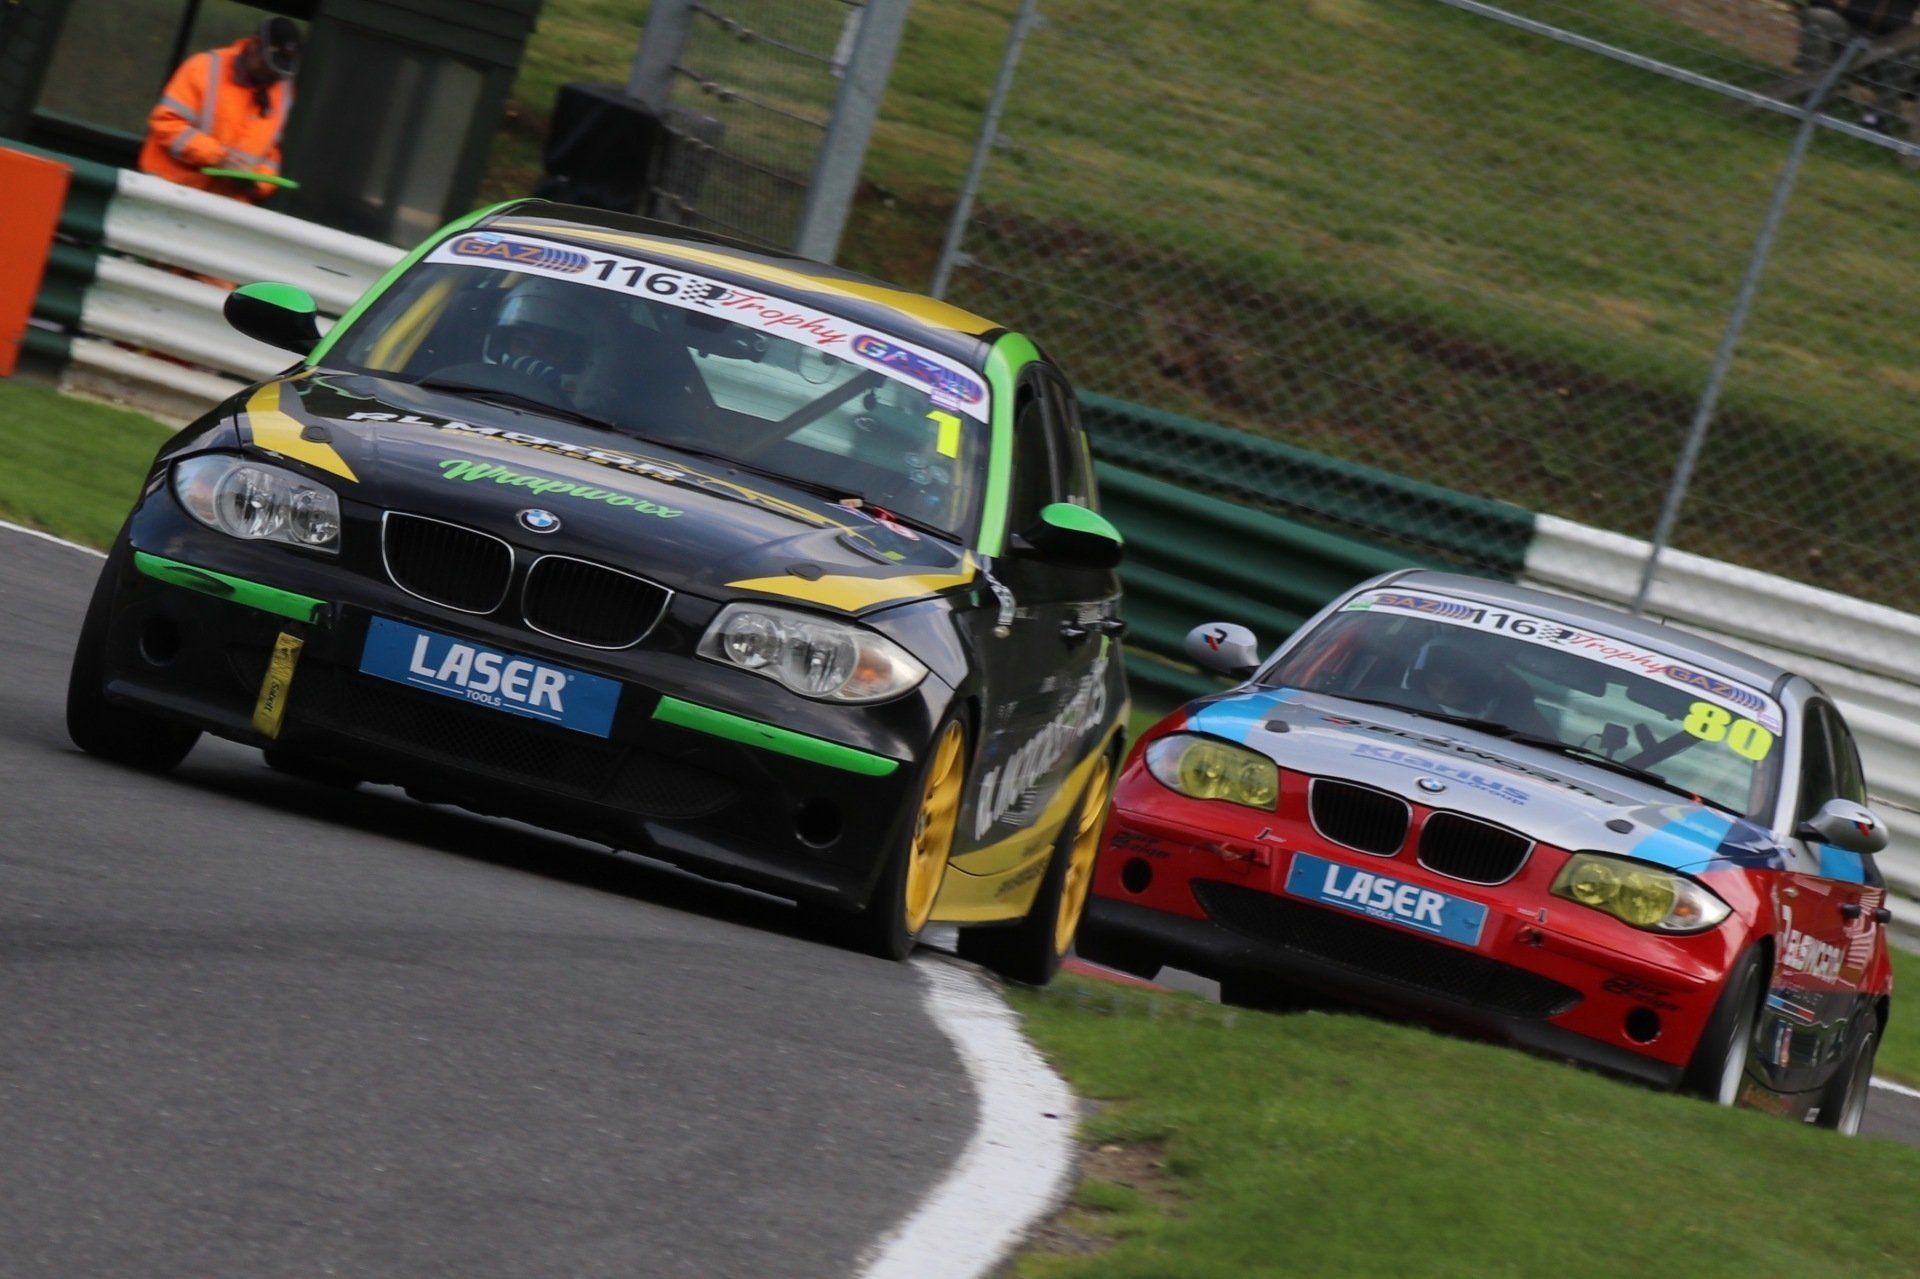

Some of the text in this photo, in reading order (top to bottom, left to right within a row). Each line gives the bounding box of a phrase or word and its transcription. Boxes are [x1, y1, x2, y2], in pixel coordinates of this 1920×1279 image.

[458, 238, 544, 265] GAZ
[592, 259, 682, 295] 116
[721, 290, 848, 345] Trophy
[346, 411, 686, 477] RL MOTOR
[926, 410, 961, 459] 1
[439, 459, 685, 519] Wrapworx
[1375, 595, 1440, 613] GAZ
[1472, 608, 1538, 636] 116
[1569, 632, 1673, 674] Trophy
[410, 634, 566, 713] LASER
[466, 689, 501, 706] TOOLS
[1683, 702, 1774, 761] 80
[1322, 864, 1446, 926] LASER
[1364, 907, 1394, 921] TOOLS
